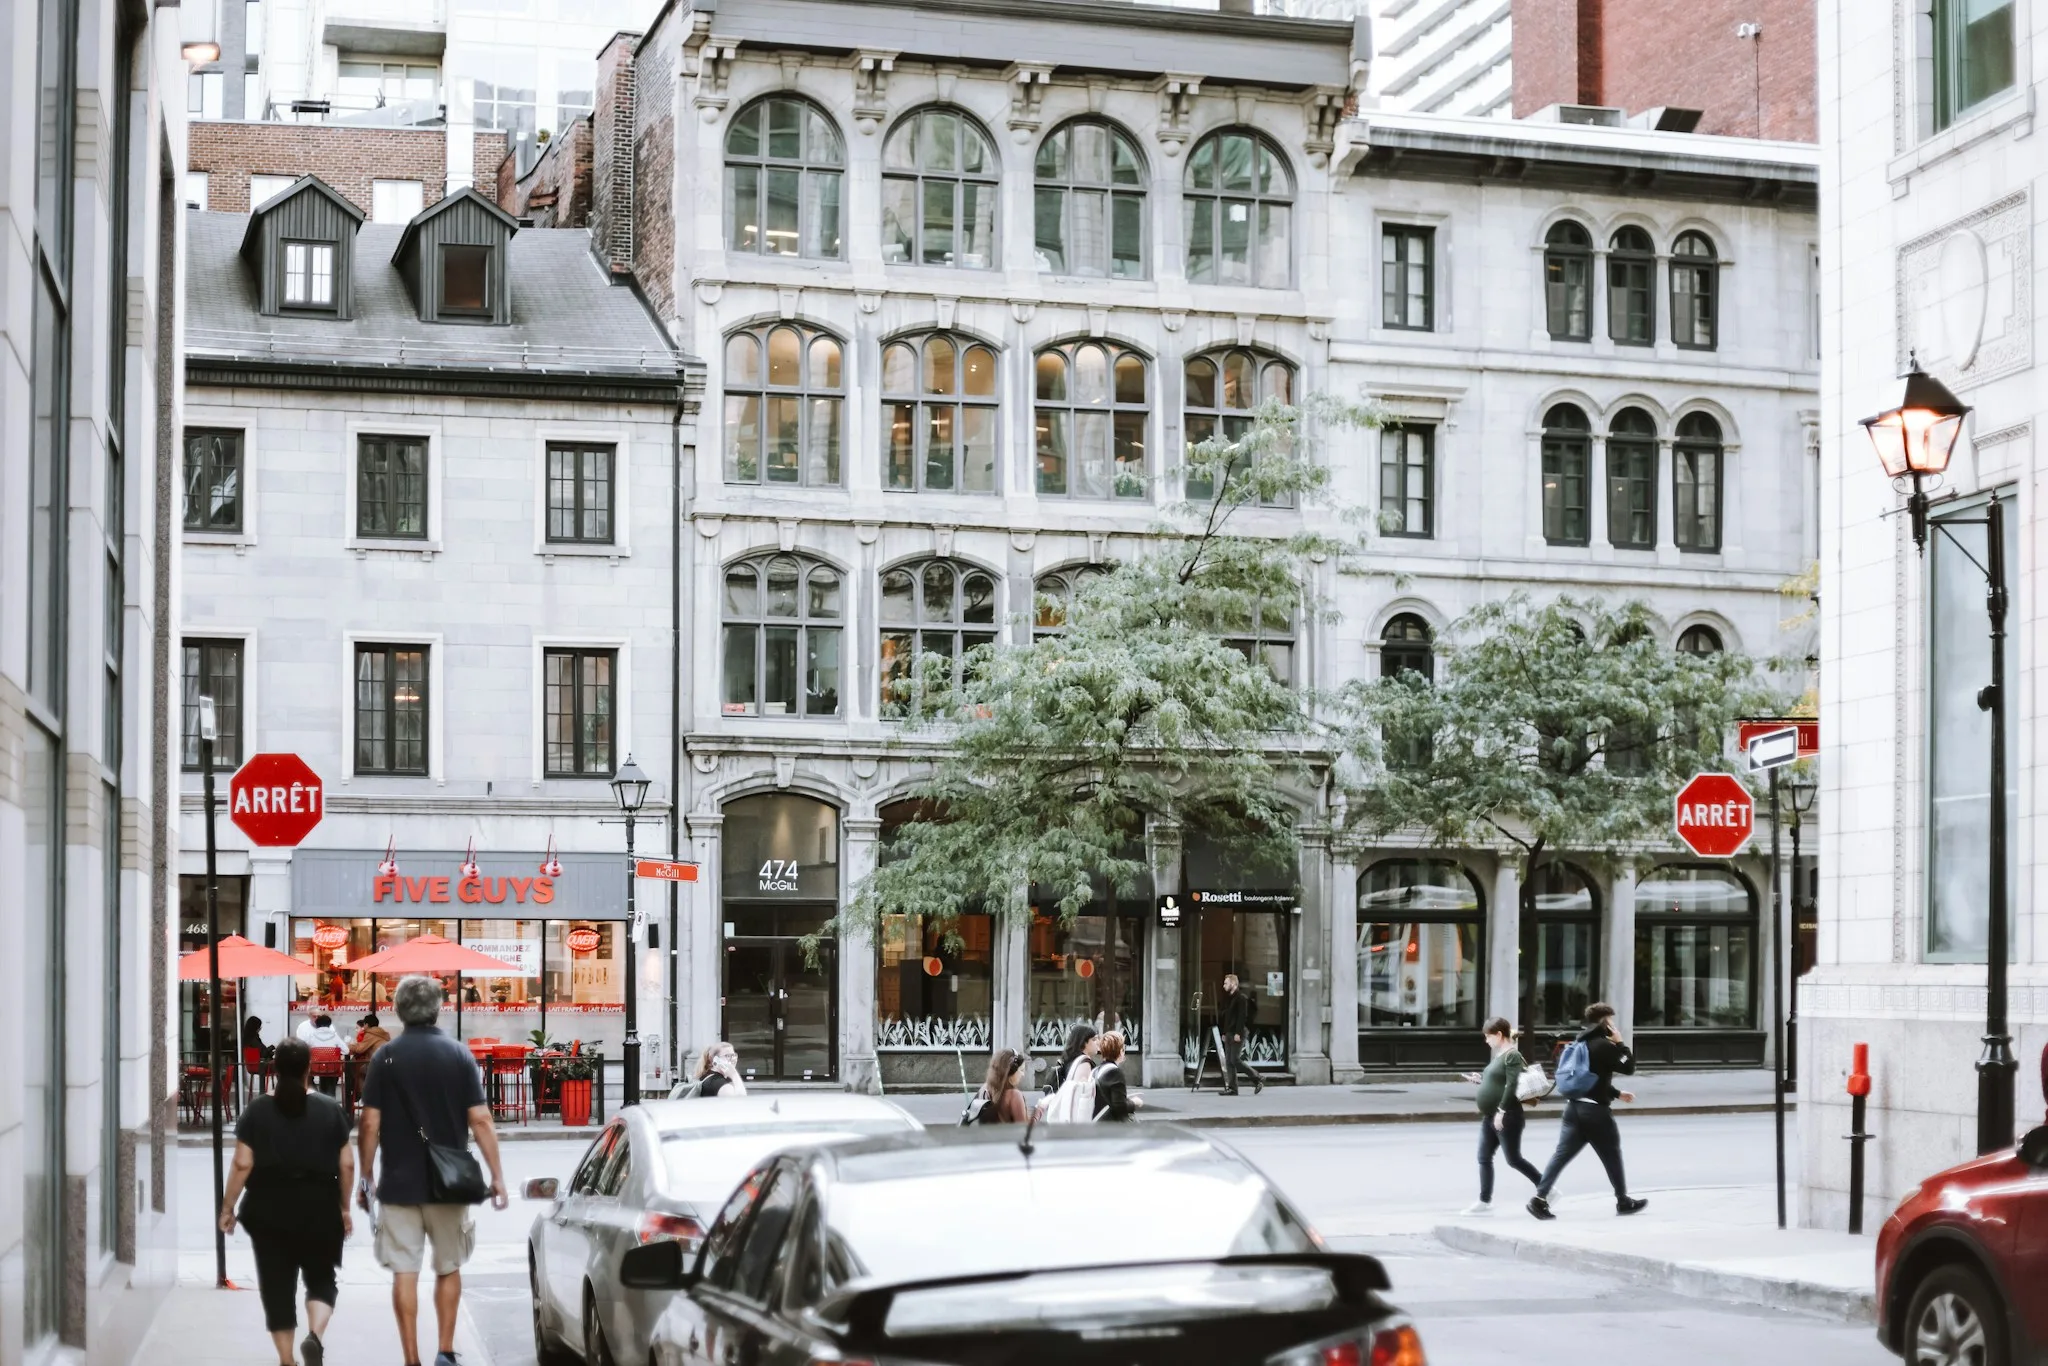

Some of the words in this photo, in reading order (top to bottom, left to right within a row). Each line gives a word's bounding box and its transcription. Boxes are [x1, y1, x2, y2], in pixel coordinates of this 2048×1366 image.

[234, 781, 319, 814] ARRÊT
[1680, 799, 1750, 827] ARRÊT
[656, 868, 680, 878] McGill
[759, 859, 799, 880] 474
[373, 876, 450, 902] FIVE
[457, 876, 555, 904] GUYS
[1201, 892, 1242, 903] Rosetti
[185, 924, 208, 934] 468
[312, 931, 348, 943] OUVERT
[566, 934, 601, 945] OUVERT
[470, 944, 532, 952] COMMANDEZ
[477, 1004, 499, 1012] FRAPPÉ
[561, 1005, 584, 1013] FRAPPÉ
[601, 1005, 623, 1013] FRAPPÉ
